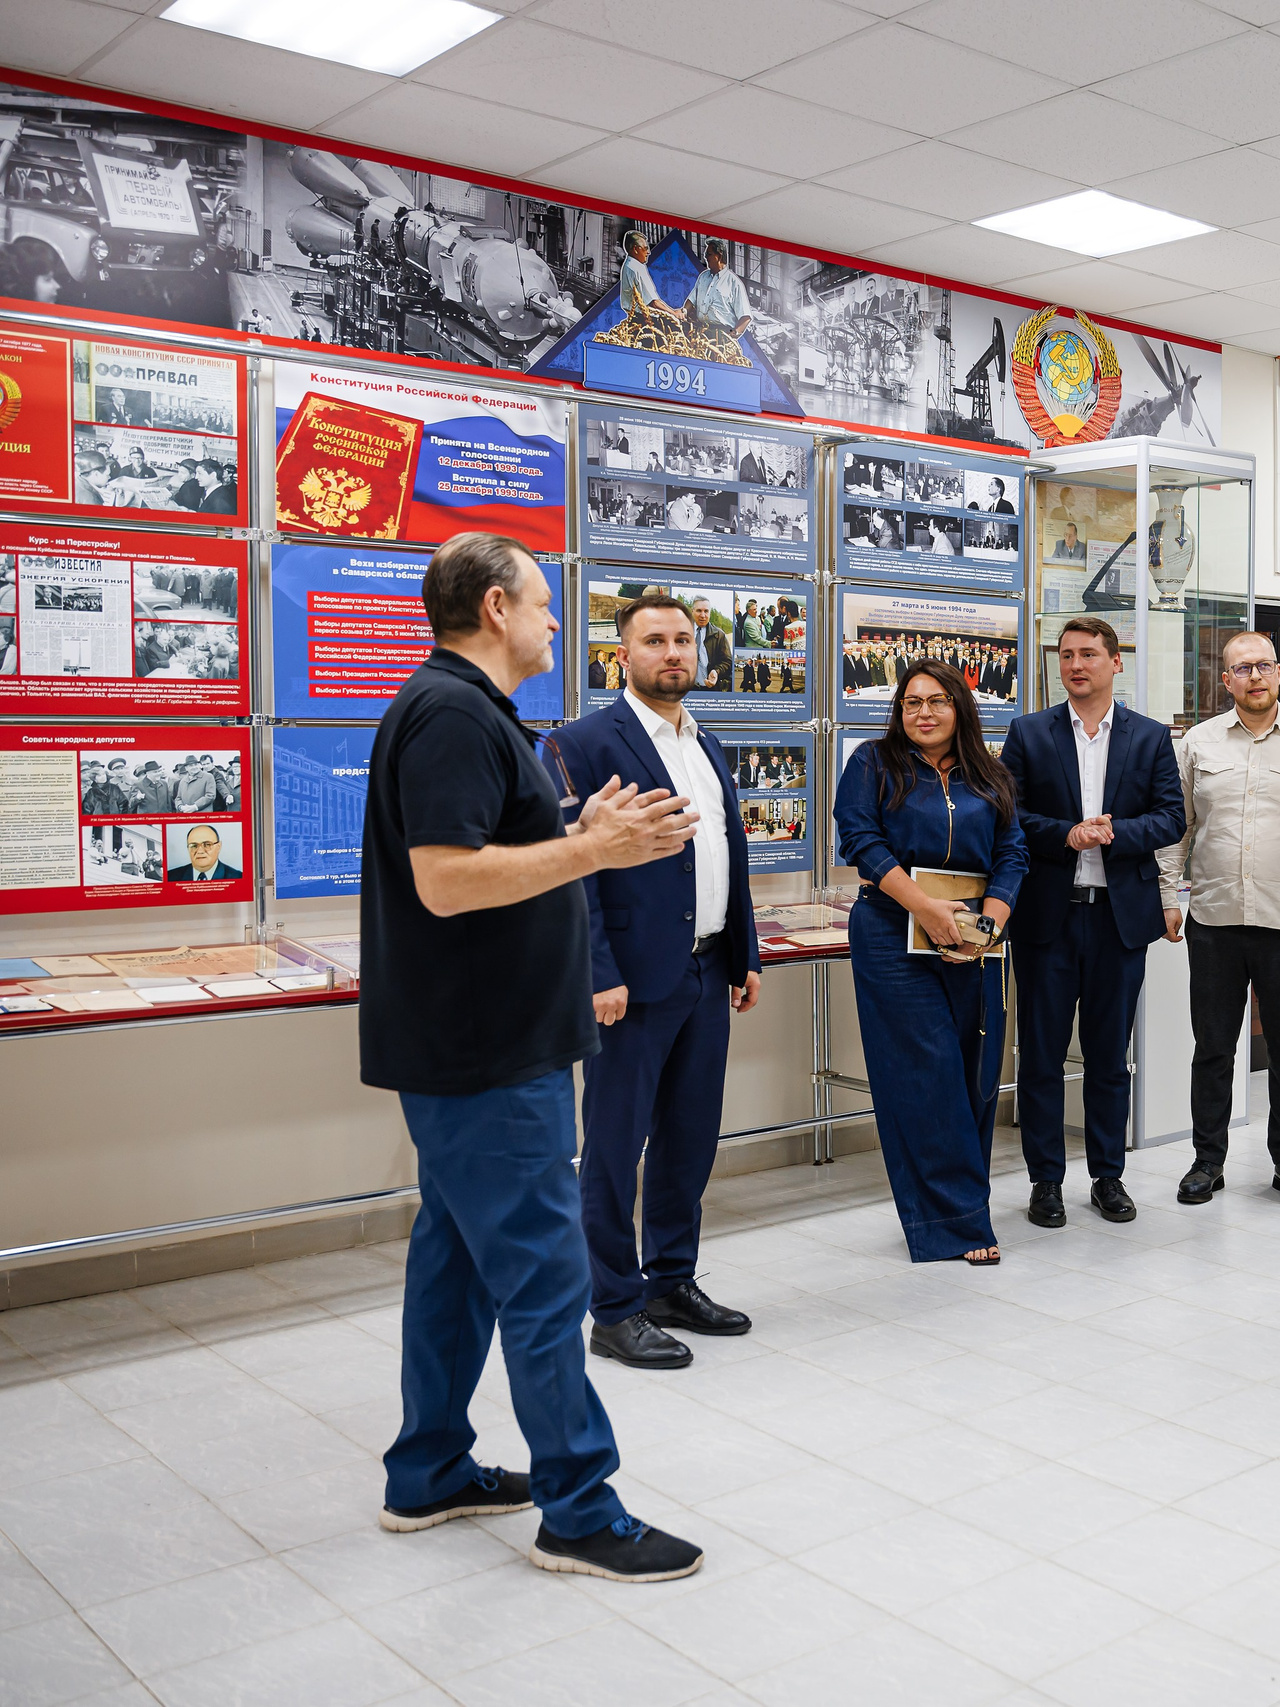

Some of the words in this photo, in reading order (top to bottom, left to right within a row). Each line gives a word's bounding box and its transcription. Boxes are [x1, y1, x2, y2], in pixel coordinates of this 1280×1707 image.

[125, 180, 173, 198] ПЕРВЫЙ
[95, 345, 120, 354] НОВАЯ
[122, 349, 174, 362] КОНСТИТУЦИЯ
[177, 356, 195, 364] СССР
[197, 358, 233, 369] ПРИНЯТА!
[136, 367, 198, 386] ПРАВДА
[646, 360, 706, 396] 1994
[310, 372, 393, 392] Конституция
[396, 384, 468, 402] Российской
[471, 394, 537, 412] Федерации
[315, 433, 389, 459] РОССИЙСКОЙ
[430, 435, 472, 448] Принята
[487, 442, 550, 457] Всенародном
[312, 442, 385, 468] ФЕДЕРАЦИИ
[461, 450, 521, 463] голосовании
[438, 456, 450, 466] 12
[452, 459, 493, 471] декабря
[495, 463, 517, 473] 1993
[519, 466, 544, 476] года.
[452, 473, 498, 486] Вступила
[507, 480, 530, 490] силу
[438, 482, 450, 491] 25
[452, 484, 493, 495] декабря
[495, 488, 517, 497] 1993
[519, 491, 544, 501] года.
[28, 536, 49, 545] Курс
[67, 538, 121, 550] Перестройку!
[54, 558, 102, 571] ИЗВЕСТИЯ
[350, 558, 374, 568] Вехи
[341, 567, 394, 578] Самарской
[372, 598, 415, 607] Федерального
[341, 621, 372, 629] депутатов
[373, 622, 406, 630] Самарской
[341, 646, 372, 654] депутатов
[54, 736, 94, 744] народных
